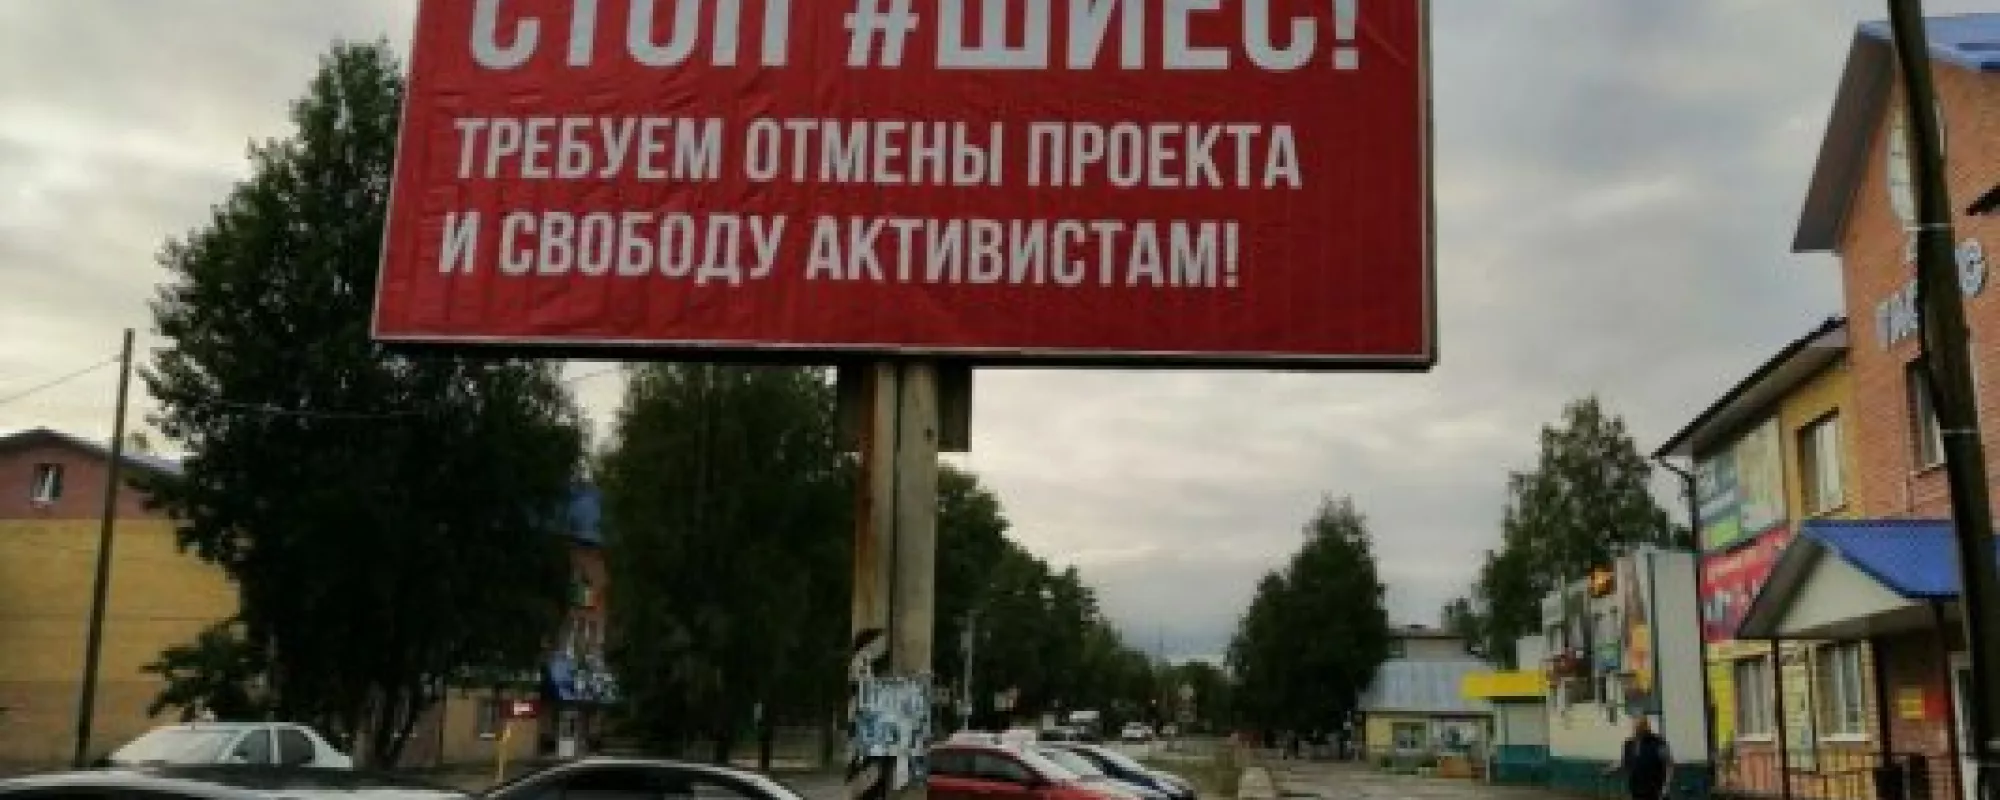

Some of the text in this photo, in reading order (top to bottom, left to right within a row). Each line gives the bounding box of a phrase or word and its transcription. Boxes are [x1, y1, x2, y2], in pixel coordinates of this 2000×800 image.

[454, 117, 1302, 188] ТРЕБУЕМ ОТМЕНЫ ПРОЕКТА
[438, 211, 1240, 288] И СВОБОДУ АКТИВИСТАМ!
